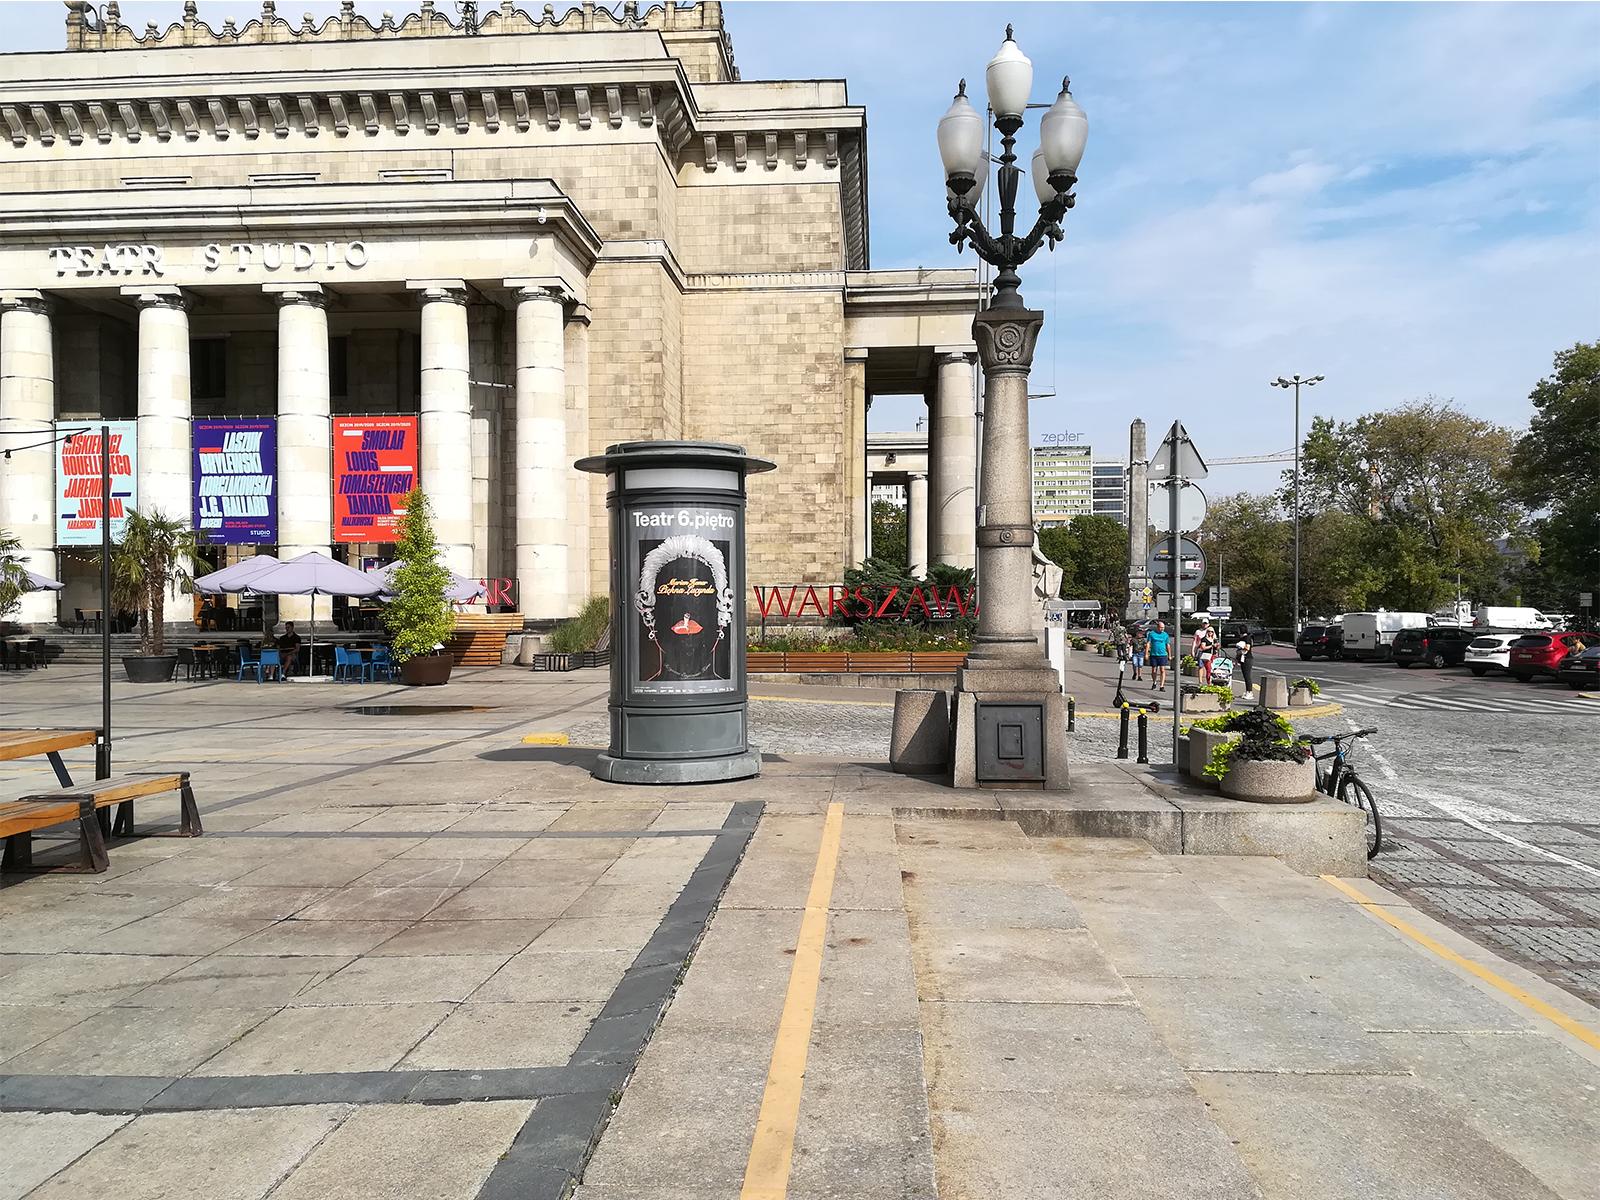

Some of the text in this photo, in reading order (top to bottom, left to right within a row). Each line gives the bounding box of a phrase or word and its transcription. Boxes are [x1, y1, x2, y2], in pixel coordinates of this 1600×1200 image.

[49, 240, 368, 276] TEATR STUDIO
[362, 430, 405, 450] SMOLAR
[1041, 430, 1085, 447] zepter
[345, 451, 379, 471] LOUIS
[339, 474, 413, 494] TOMASZEWSKI
[222, 495, 269, 517] BALLARD
[346, 495, 391, 515] TAMARA
[633, 510, 734, 530] Teatr 6.piętro
[753, 584, 980, 618] WARSZAW
